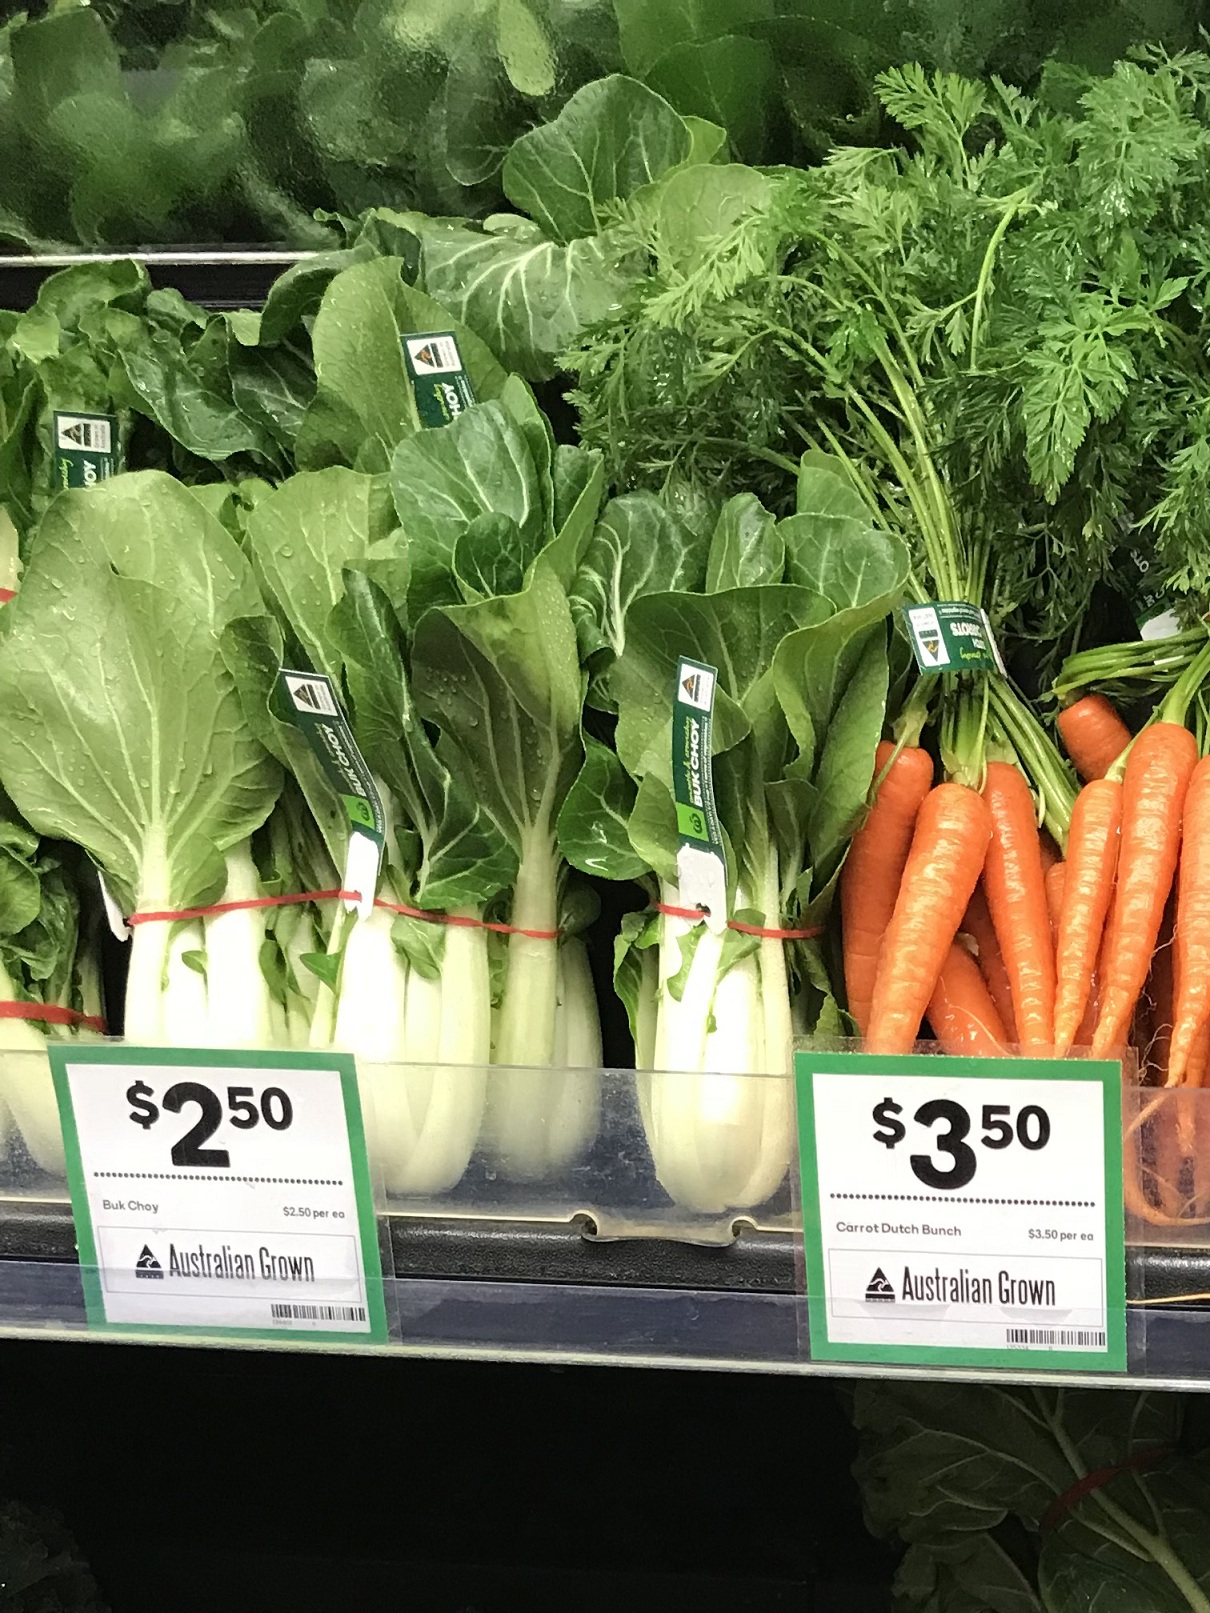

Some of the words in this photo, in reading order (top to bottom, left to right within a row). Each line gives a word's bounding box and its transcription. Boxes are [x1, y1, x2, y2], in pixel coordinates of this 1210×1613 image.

[322, 723, 350, 766] CHOY
[690, 716, 700, 771] CHOY
[344, 767, 367, 797] BUK
[691, 771, 703, 807] BUK
[102, 1200, 125, 1211] Buk
[128, 1201, 159, 1214] Choy
[283, 1206, 311, 1217] $2.50
[313, 1210, 329, 1219] per
[332, 1211, 346, 1219] ea
[836, 1221, 879, 1233] Carrot
[881, 1223, 919, 1235] Dutch
[922, 1225, 962, 1237] Bunch
[1028, 1228, 1058, 1240] $3.50
[1060, 1231, 1078, 1241] per
[1080, 1232, 1094, 1241] ea
[169, 1243, 256, 1280] Australian
[259, 1247, 315, 1282] Grown
[902, 1266, 992, 1305] Australian
[998, 1270, 1056, 1306] Grown
